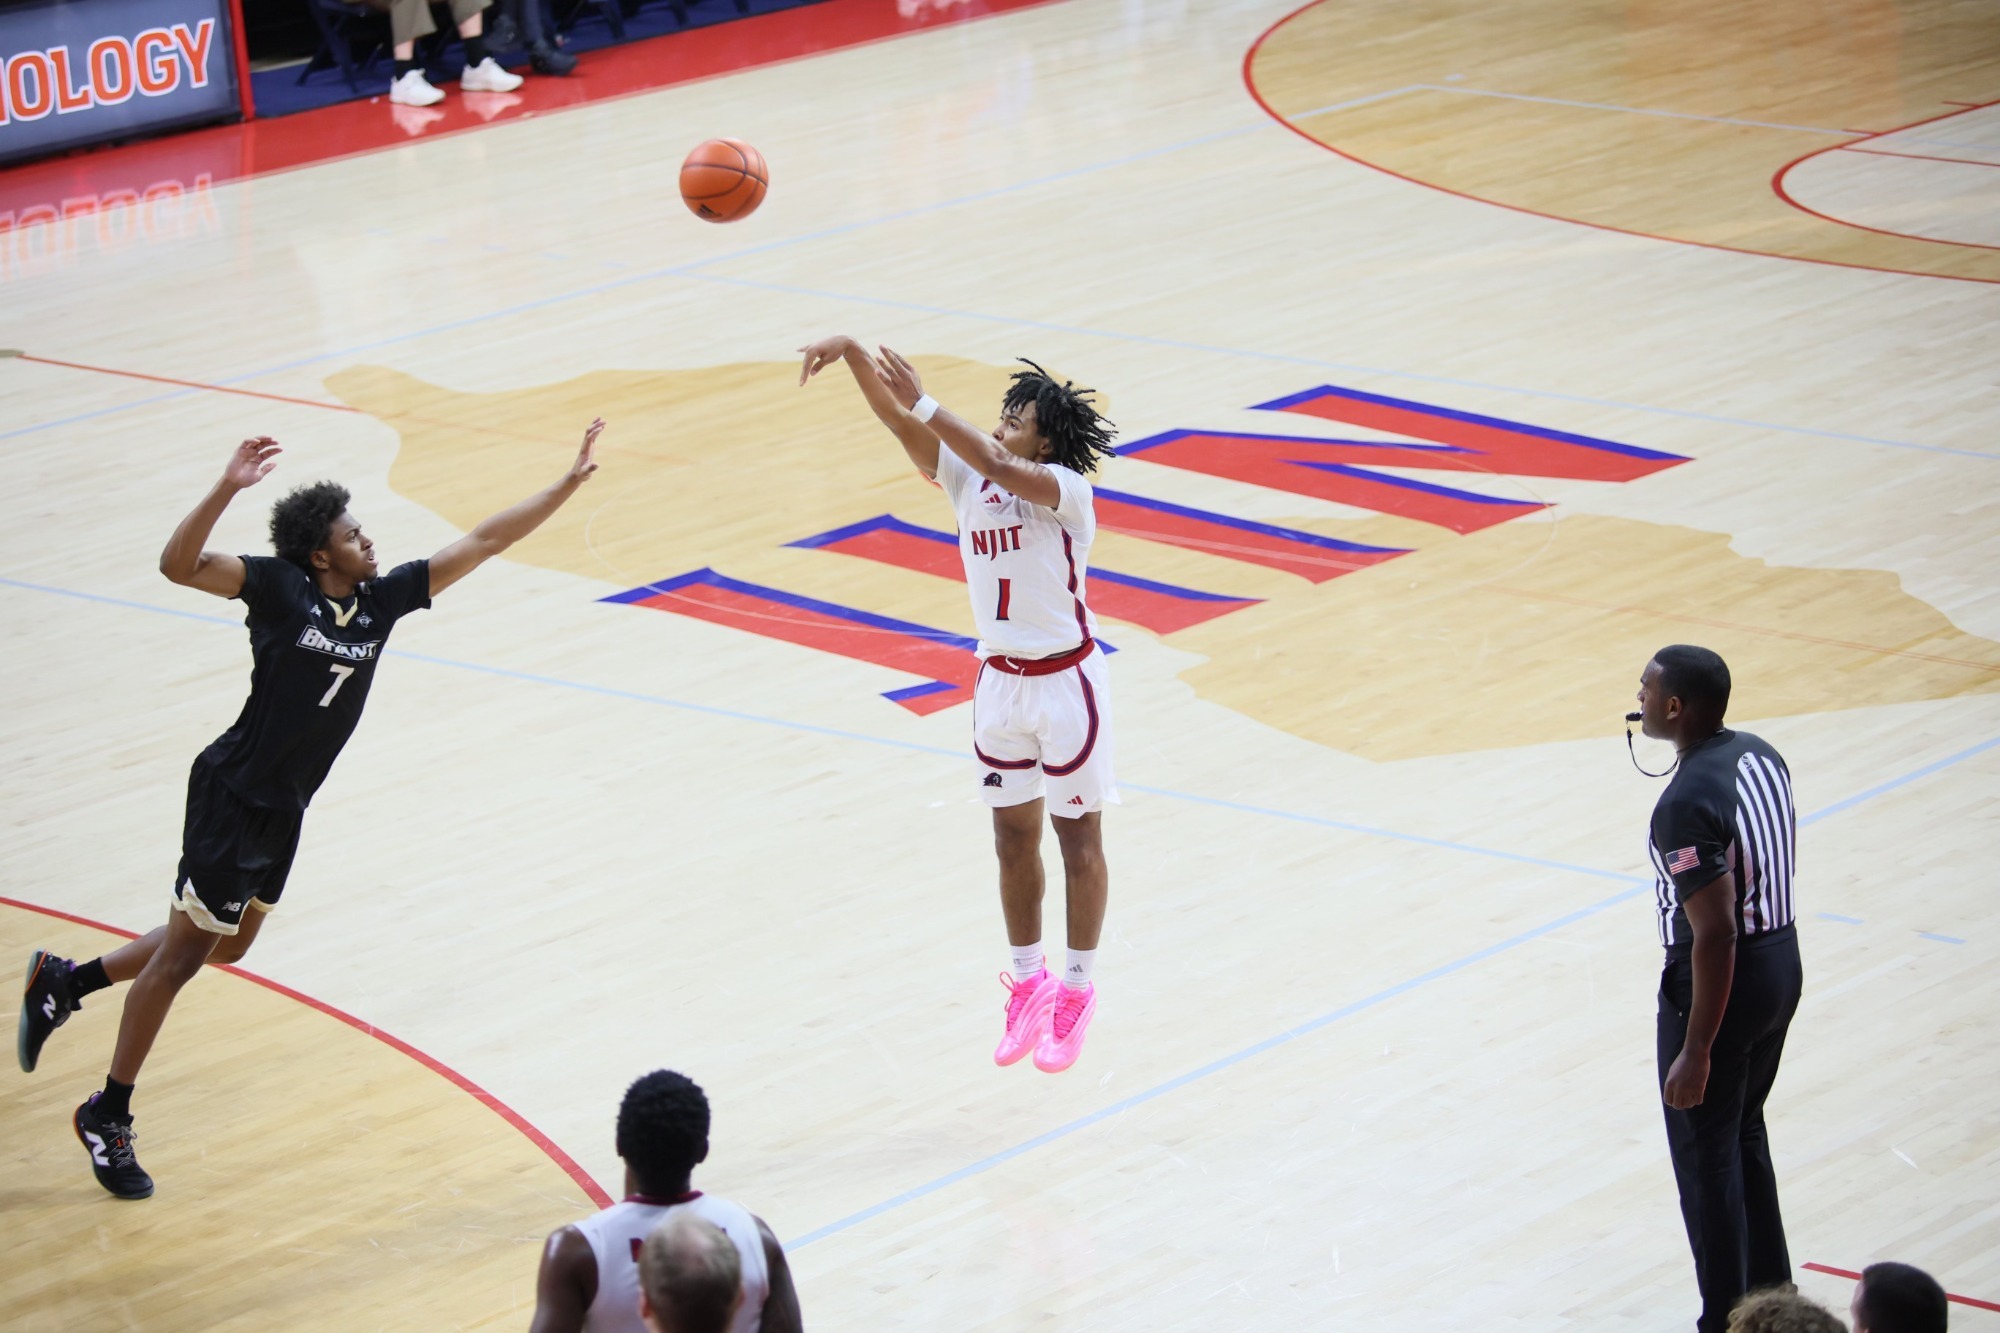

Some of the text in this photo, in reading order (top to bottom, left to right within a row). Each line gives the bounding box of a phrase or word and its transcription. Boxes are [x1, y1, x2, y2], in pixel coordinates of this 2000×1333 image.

[0, 18, 215, 126] OLOGY
[971, 524, 1023, 561] NJIT
[995, 577, 1011, 621] 1
[300, 627, 378, 659] BRYANT
[318, 663, 355, 708] 7
